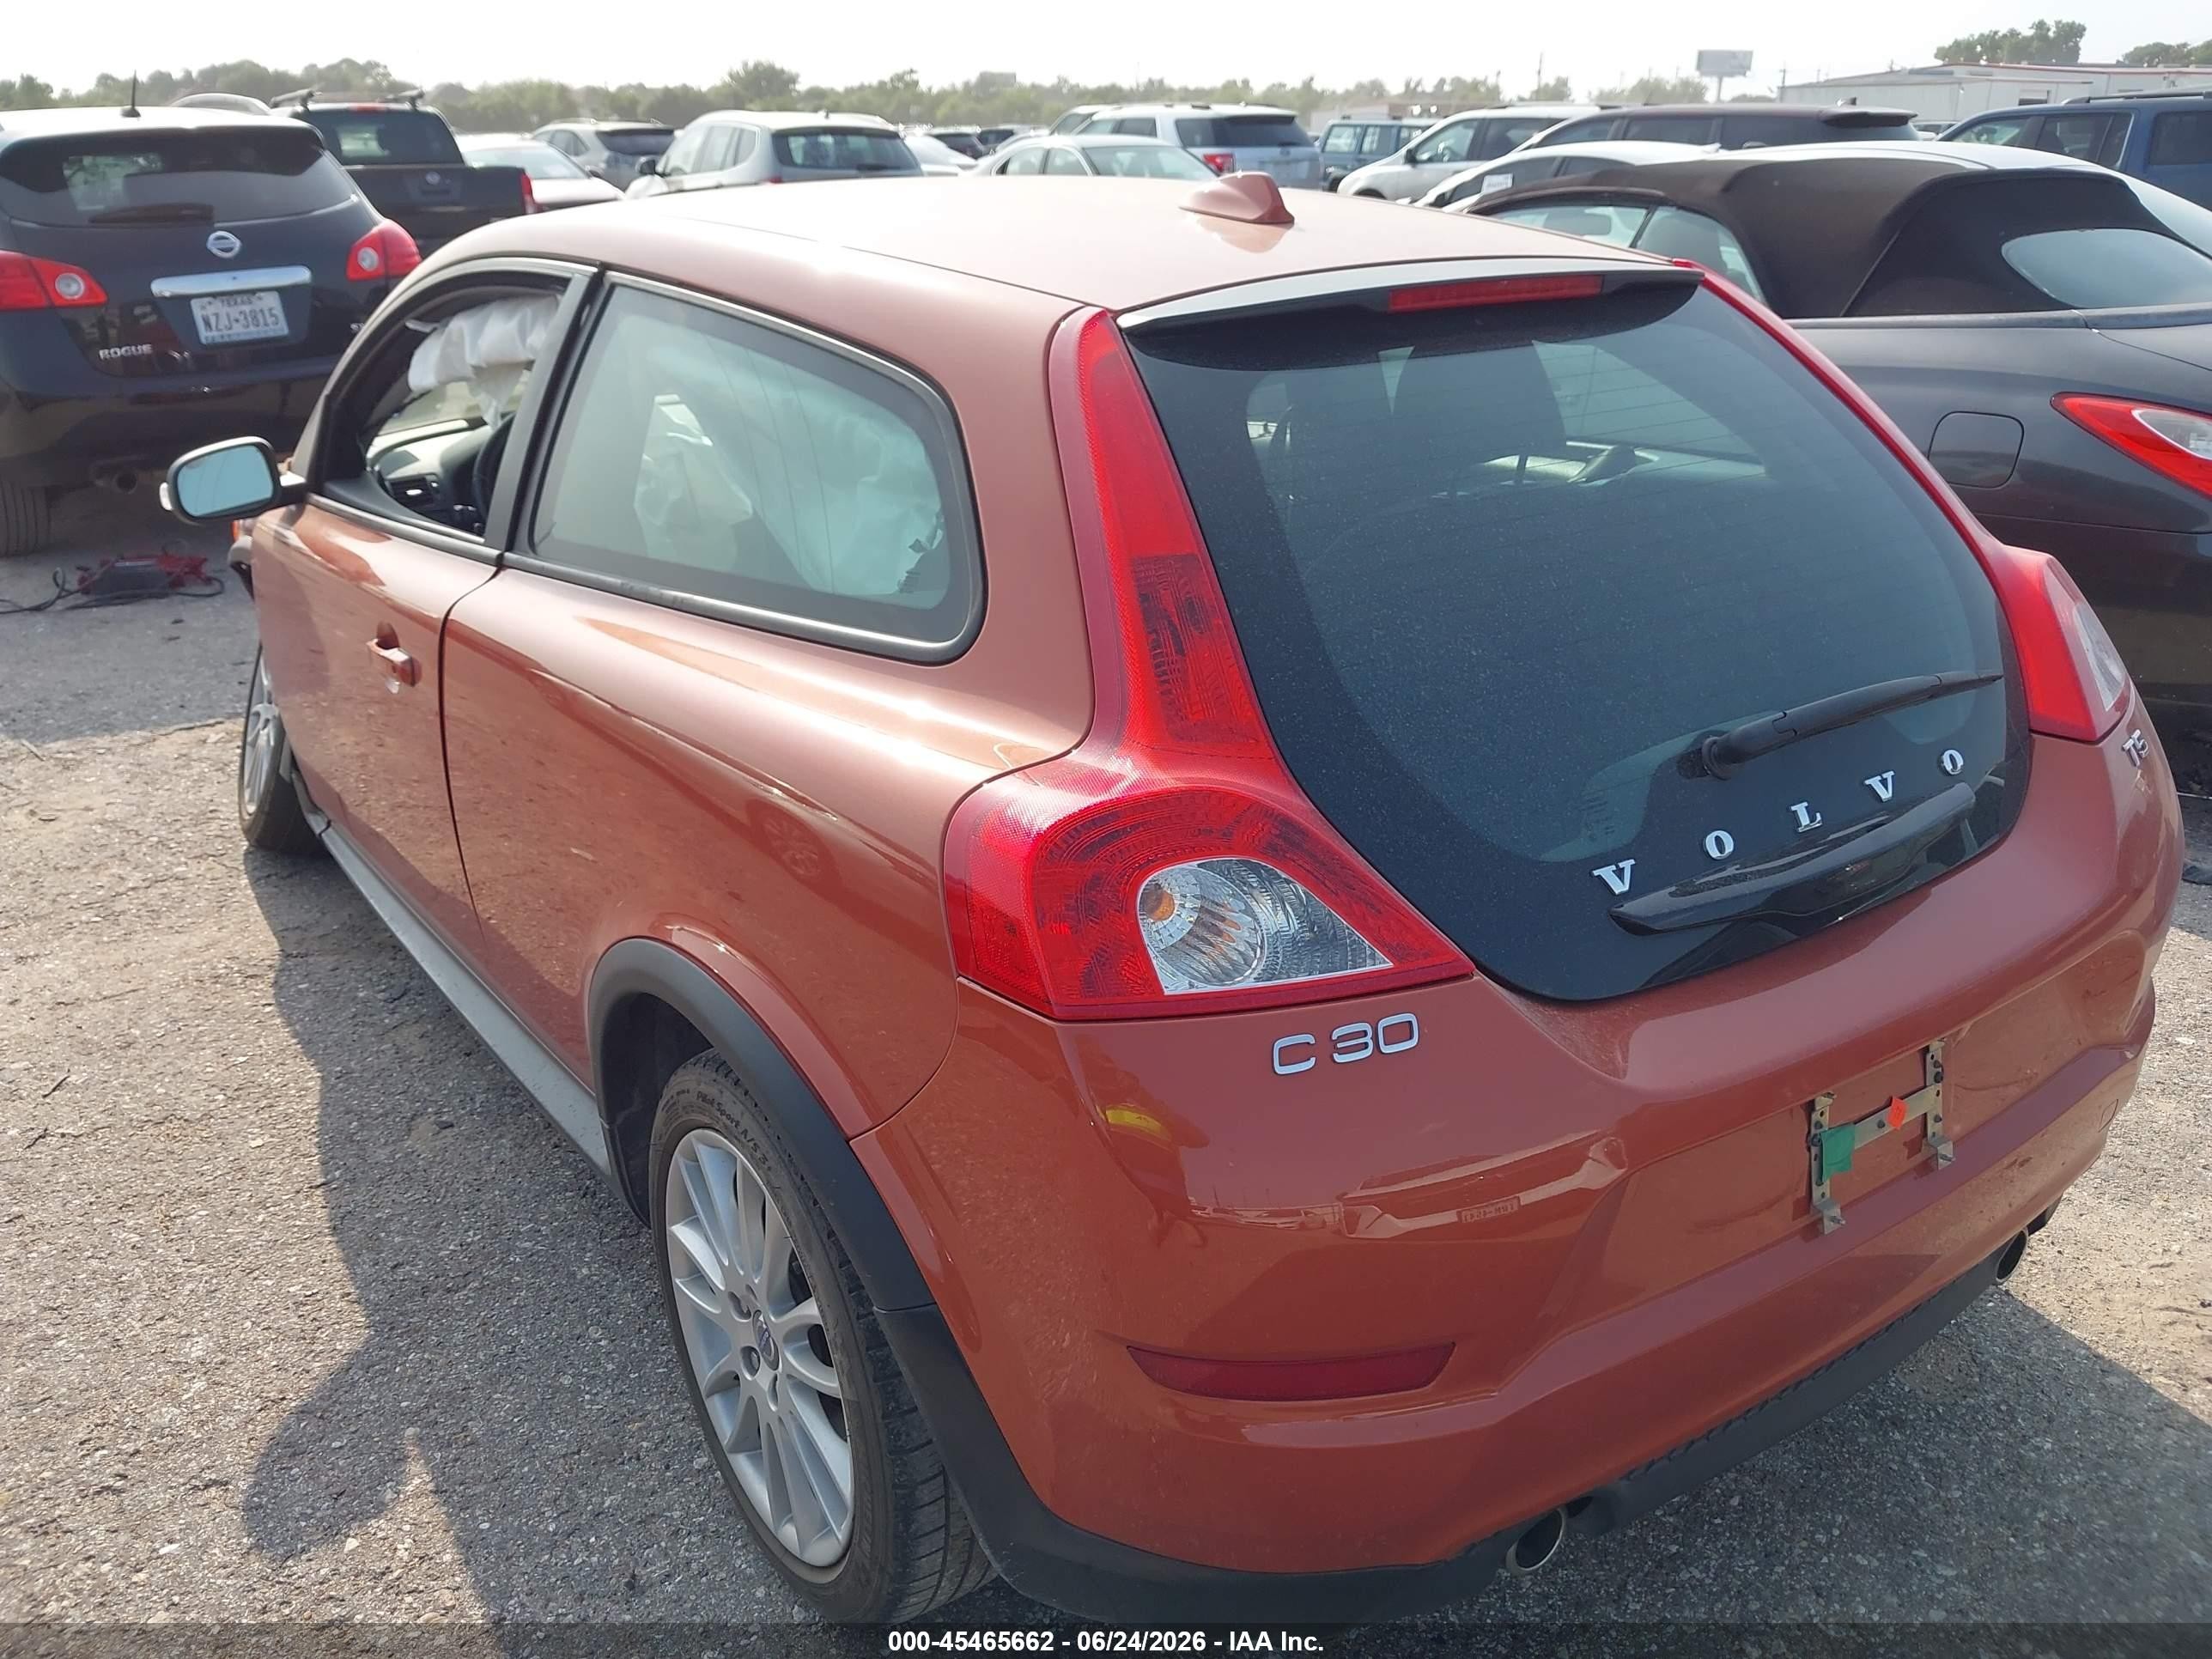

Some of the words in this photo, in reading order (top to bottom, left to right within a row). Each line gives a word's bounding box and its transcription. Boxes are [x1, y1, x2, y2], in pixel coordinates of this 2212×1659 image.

[99, 343, 152, 360] ROGUE
[2122, 728, 2148, 767] T5
[1592, 749, 1964, 896] VOLVO
[715, 1102, 740, 1128] Sport
